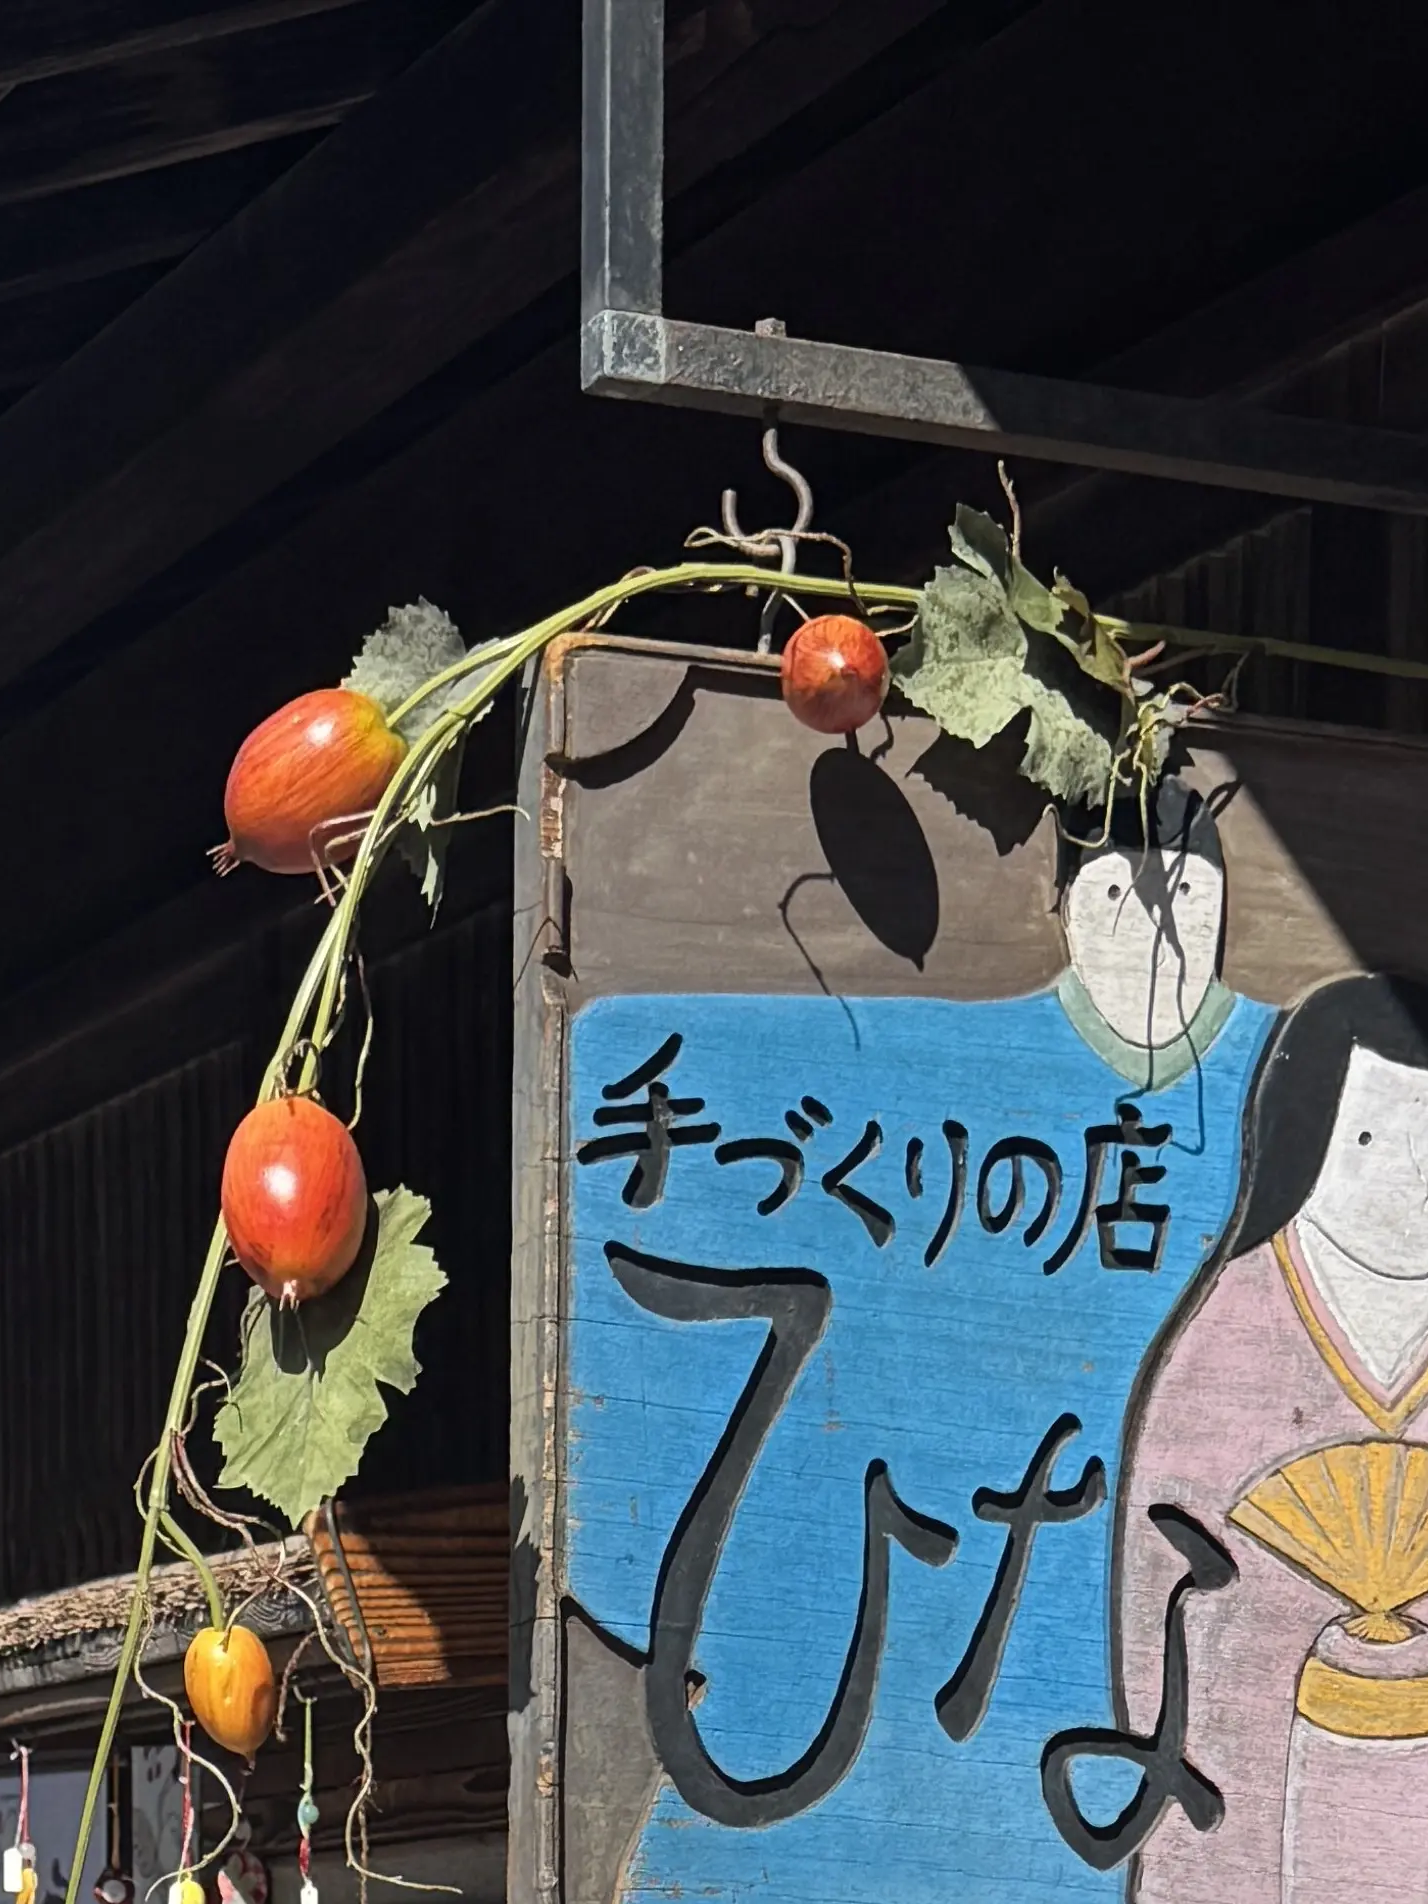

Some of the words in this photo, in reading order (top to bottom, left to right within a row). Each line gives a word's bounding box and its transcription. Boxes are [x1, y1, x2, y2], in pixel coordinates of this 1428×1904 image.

[575, 1032, 1174, 1275] 手づくりの店
[603, 1239, 1241, 1871] ひな
